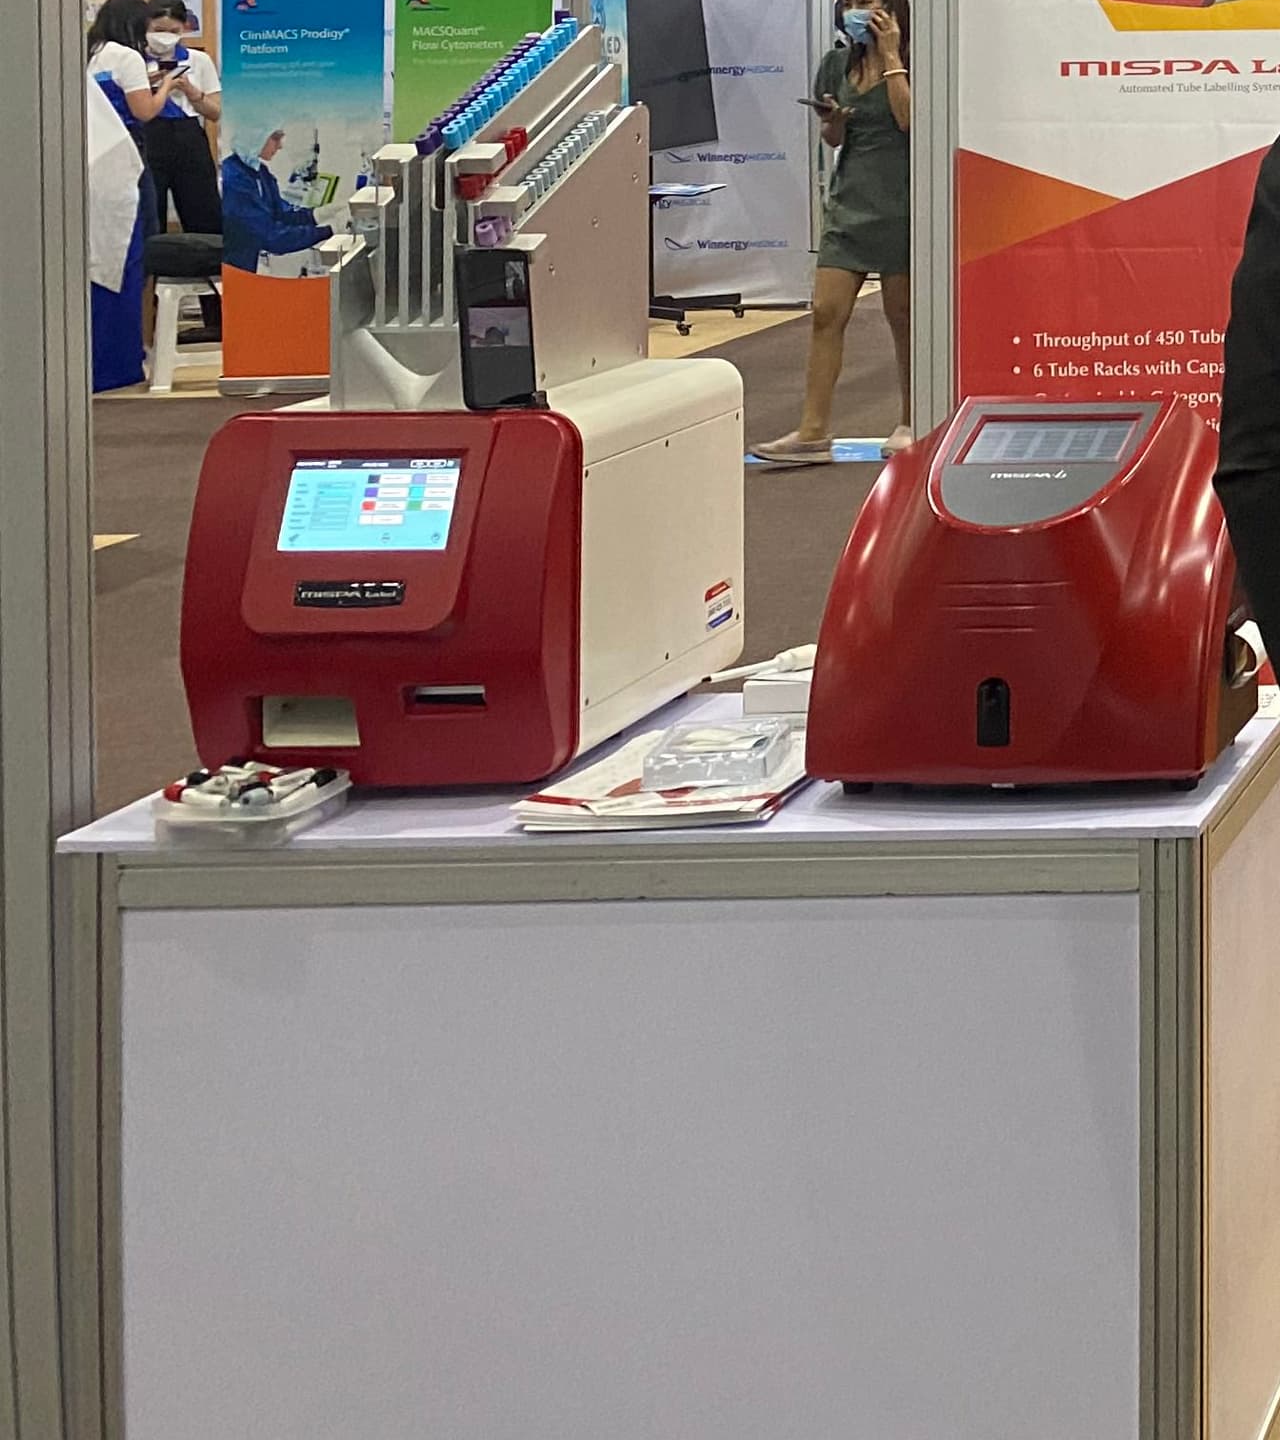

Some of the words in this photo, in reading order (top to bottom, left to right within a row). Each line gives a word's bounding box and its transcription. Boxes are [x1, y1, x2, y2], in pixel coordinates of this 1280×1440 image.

[240, 28, 298, 41] CliniMACS
[240, 43, 289, 54] Platform
[412, 39, 439, 51] Flow
[440, 38, 504, 52] Cytometers
[1119, 83, 1174, 93] Automated
[1176, 83, 1202, 93] Tube
[1204, 82, 1250, 94] Labelling
[1033, 331, 1130, 351] Throughput
[1134, 330, 1151, 346] of
[1155, 330, 1185, 346] 450
[1033, 362, 1043, 377] 6
[1048, 361, 1089, 377] Tube
[1093, 360, 1141, 376] Racks
[1145, 359, 1182, 375] with
[1187, 359, 1225, 378] Capa
